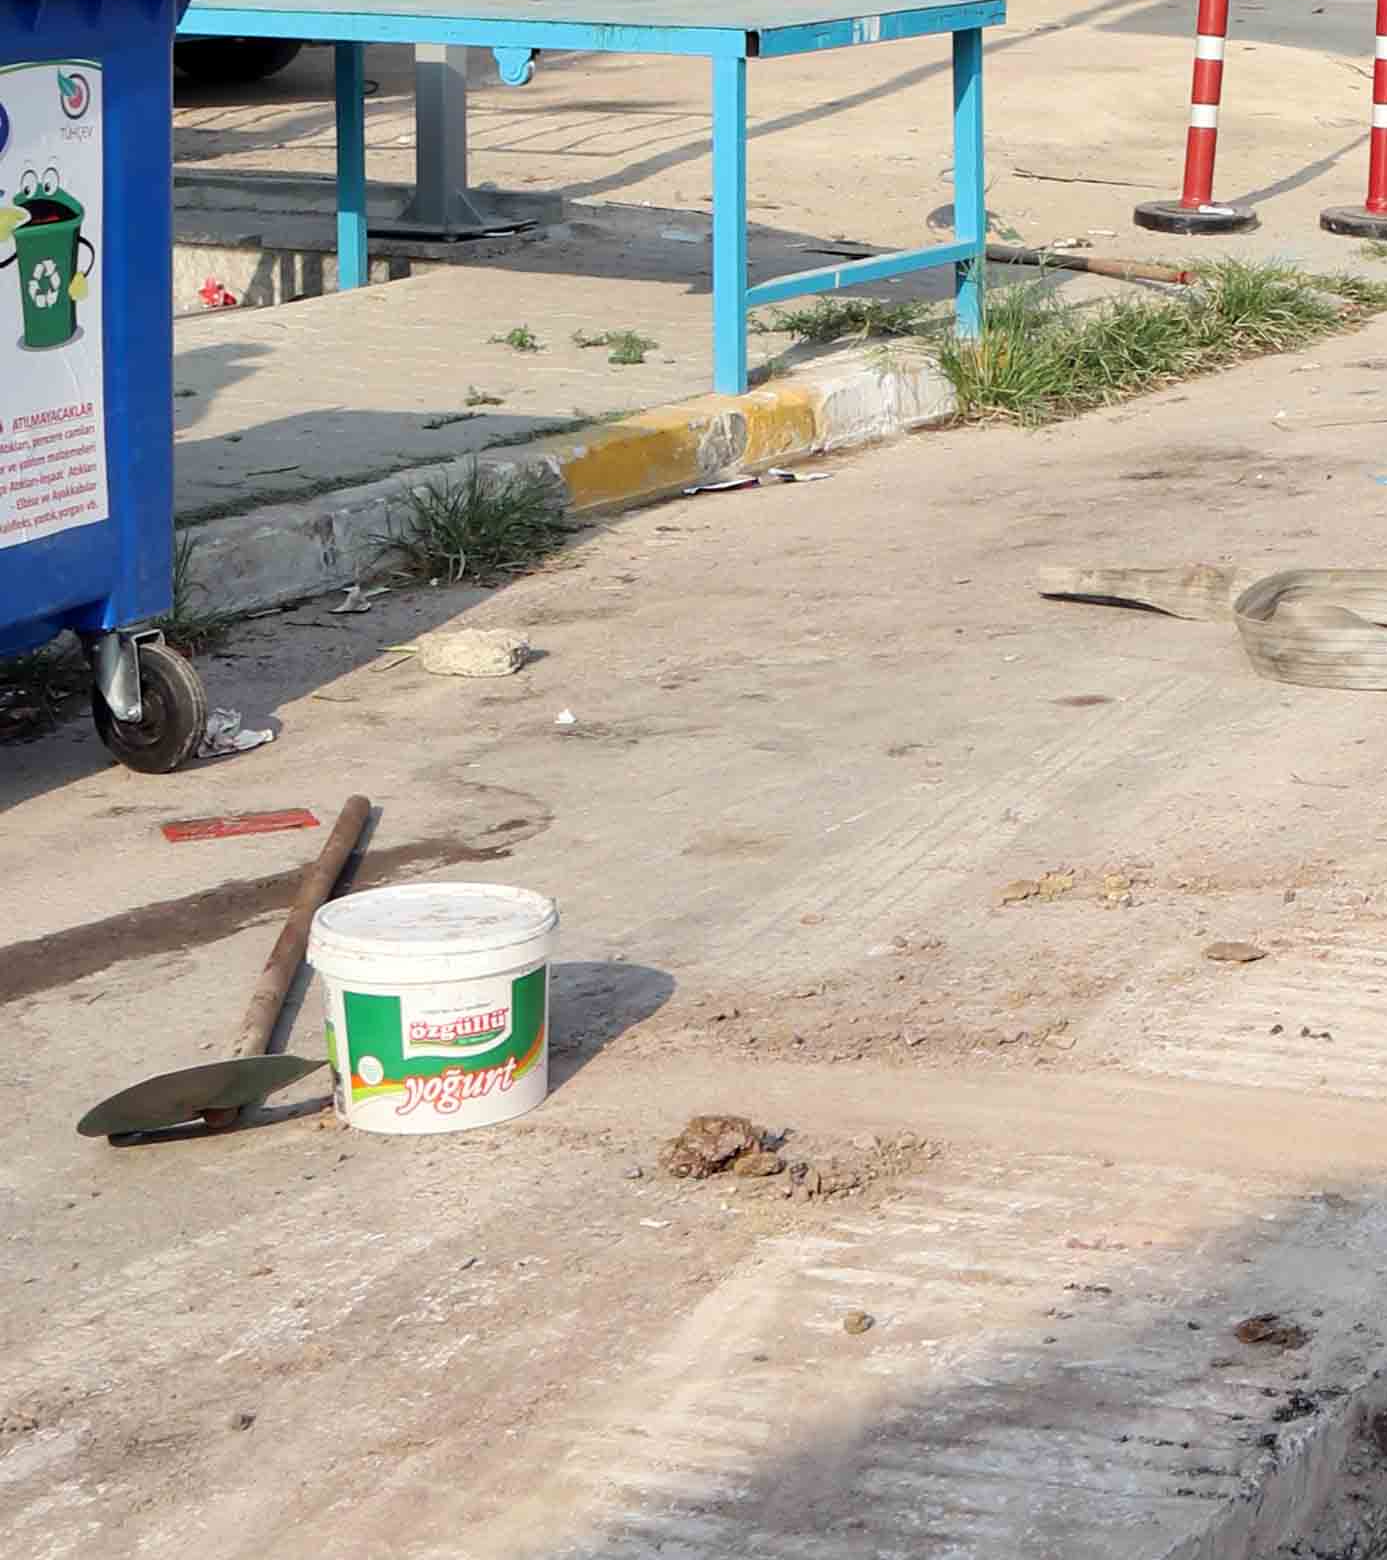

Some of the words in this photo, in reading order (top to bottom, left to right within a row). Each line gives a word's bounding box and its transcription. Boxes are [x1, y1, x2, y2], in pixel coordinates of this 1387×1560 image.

[13, 403, 94, 431] ATILMAYACAKLAR
[409, 1009, 506, 1040] özgüllü
[397, 1056, 519, 1117] yoğurt
